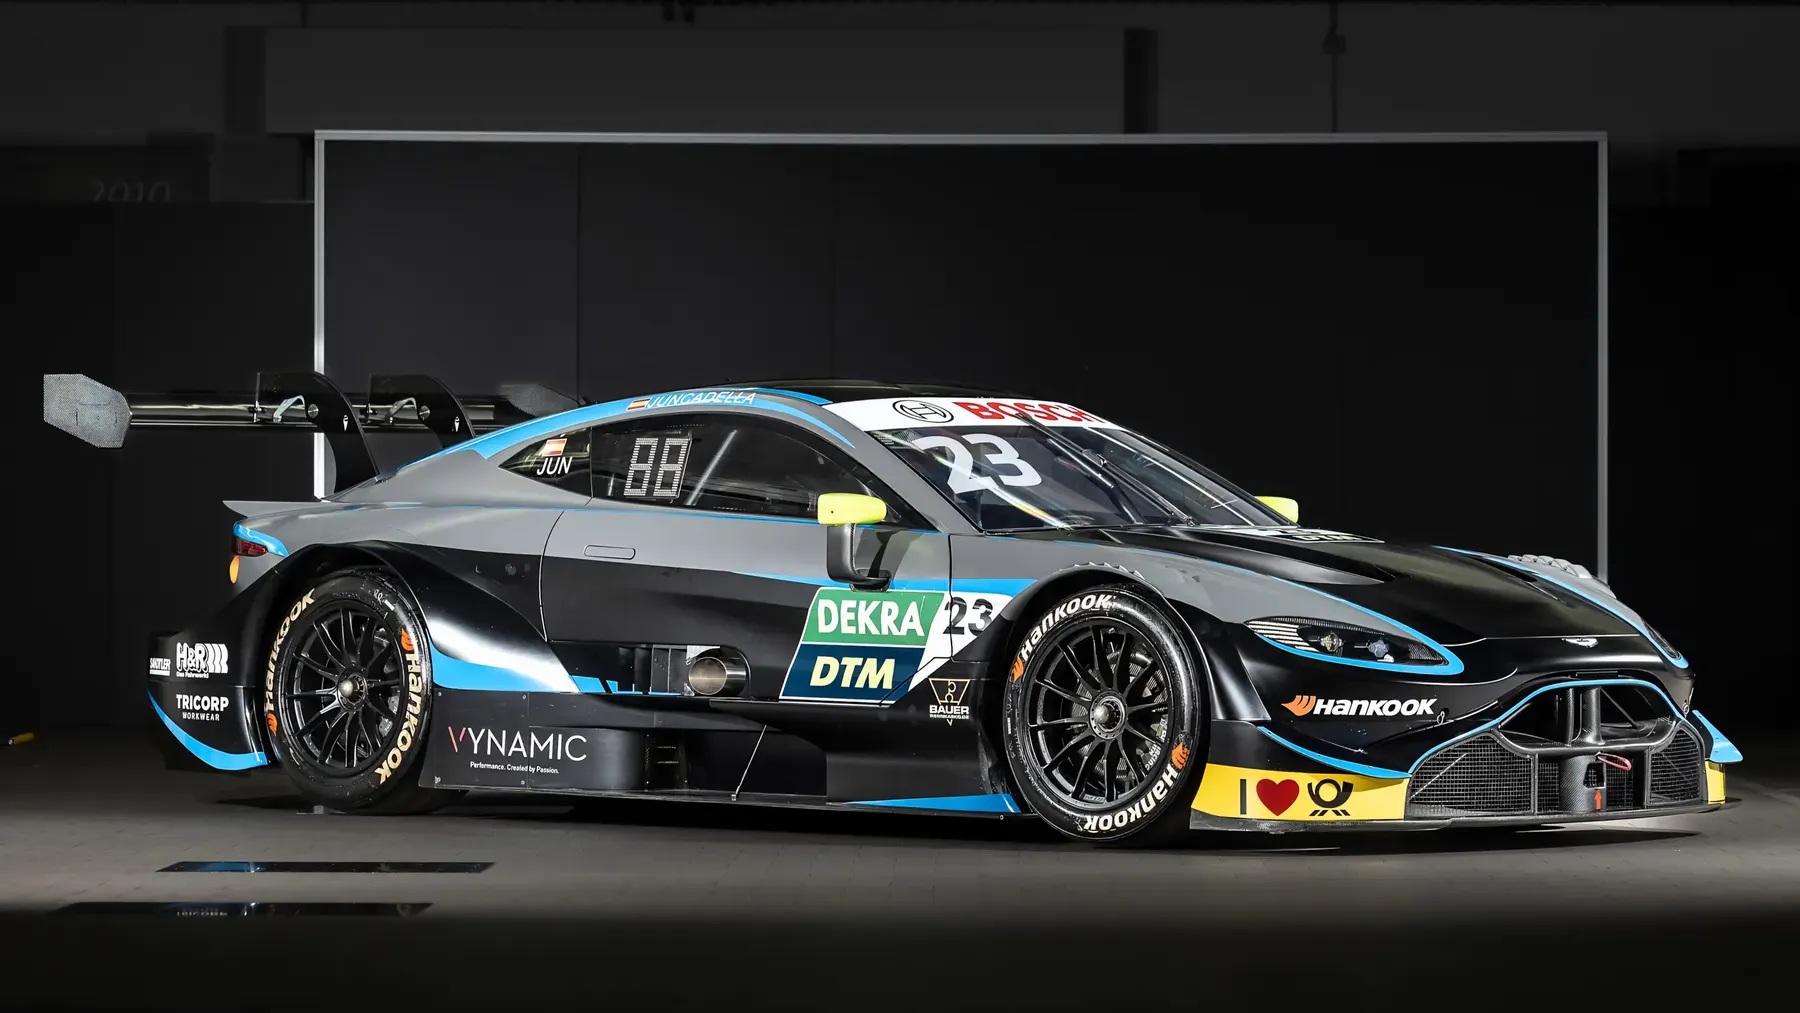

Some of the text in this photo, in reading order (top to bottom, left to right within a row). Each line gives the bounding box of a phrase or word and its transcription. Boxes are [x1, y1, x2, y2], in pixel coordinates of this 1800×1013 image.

[952, 402, 1106, 422] BOSCH
[536, 456, 572, 476] JUN
[912, 433, 1042, 494] 23
[817, 599, 925, 637] DEKRA
[942, 596, 994, 637] 23
[809, 655, 895, 690] DTM
[176, 694, 229, 711] TRICORP
[182, 711, 220, 721] WORKWEAR
[929, 704, 970, 715] BAUER
[448, 726, 587, 761] VYNAMIC
[470, 761, 559, 774] Performance. Created by Passion.
[1239, 778, 1247, 816] I
